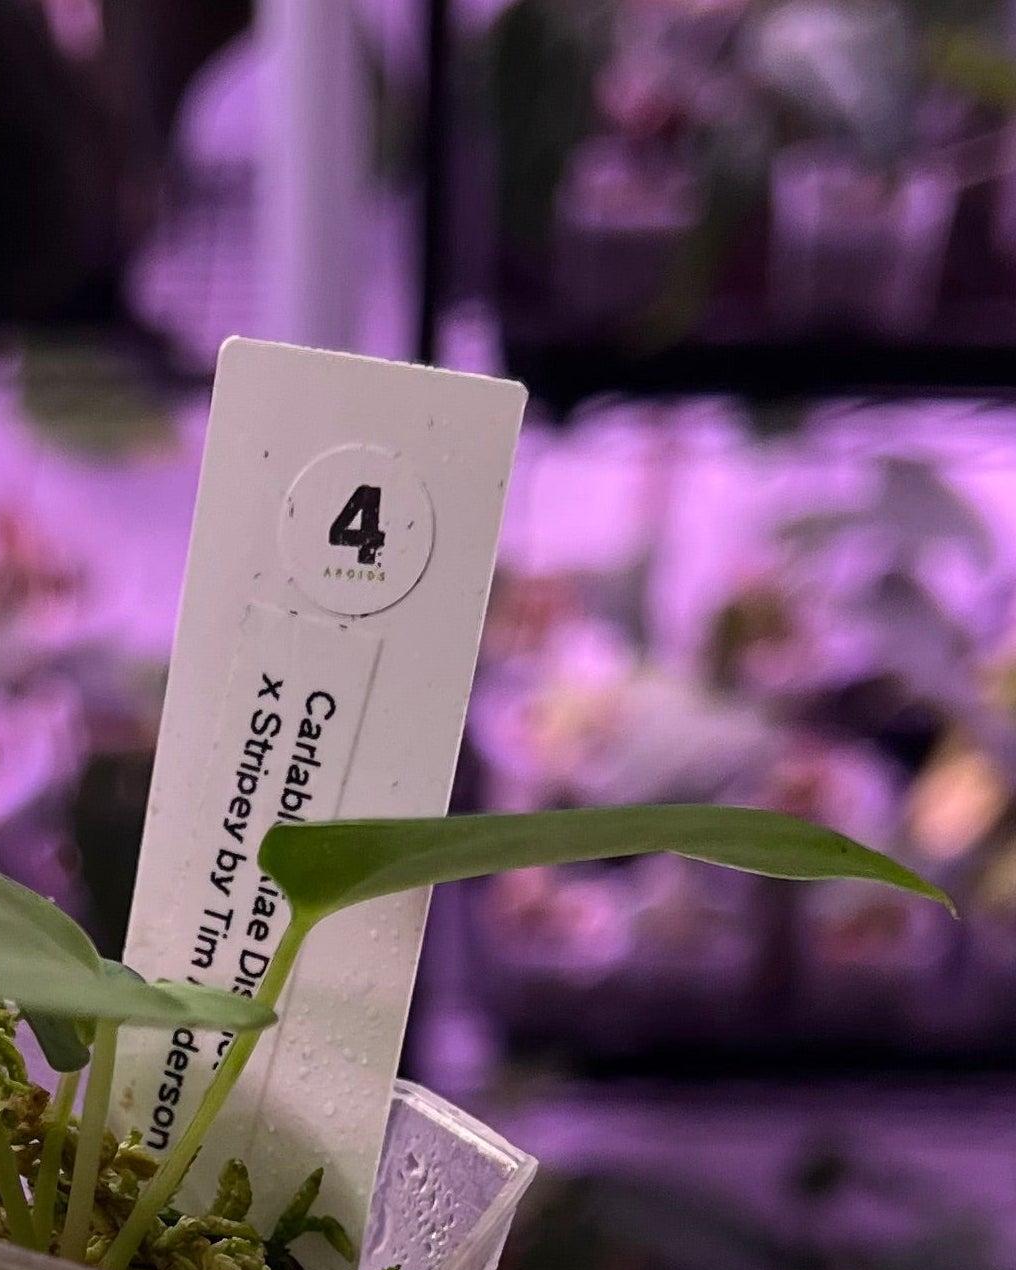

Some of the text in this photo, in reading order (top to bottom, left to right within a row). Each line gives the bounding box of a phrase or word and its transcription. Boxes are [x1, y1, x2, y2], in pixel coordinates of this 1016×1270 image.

[328, 484, 386, 565] 4
[146, 672, 284, 1151] x Stripey by Tim derson
